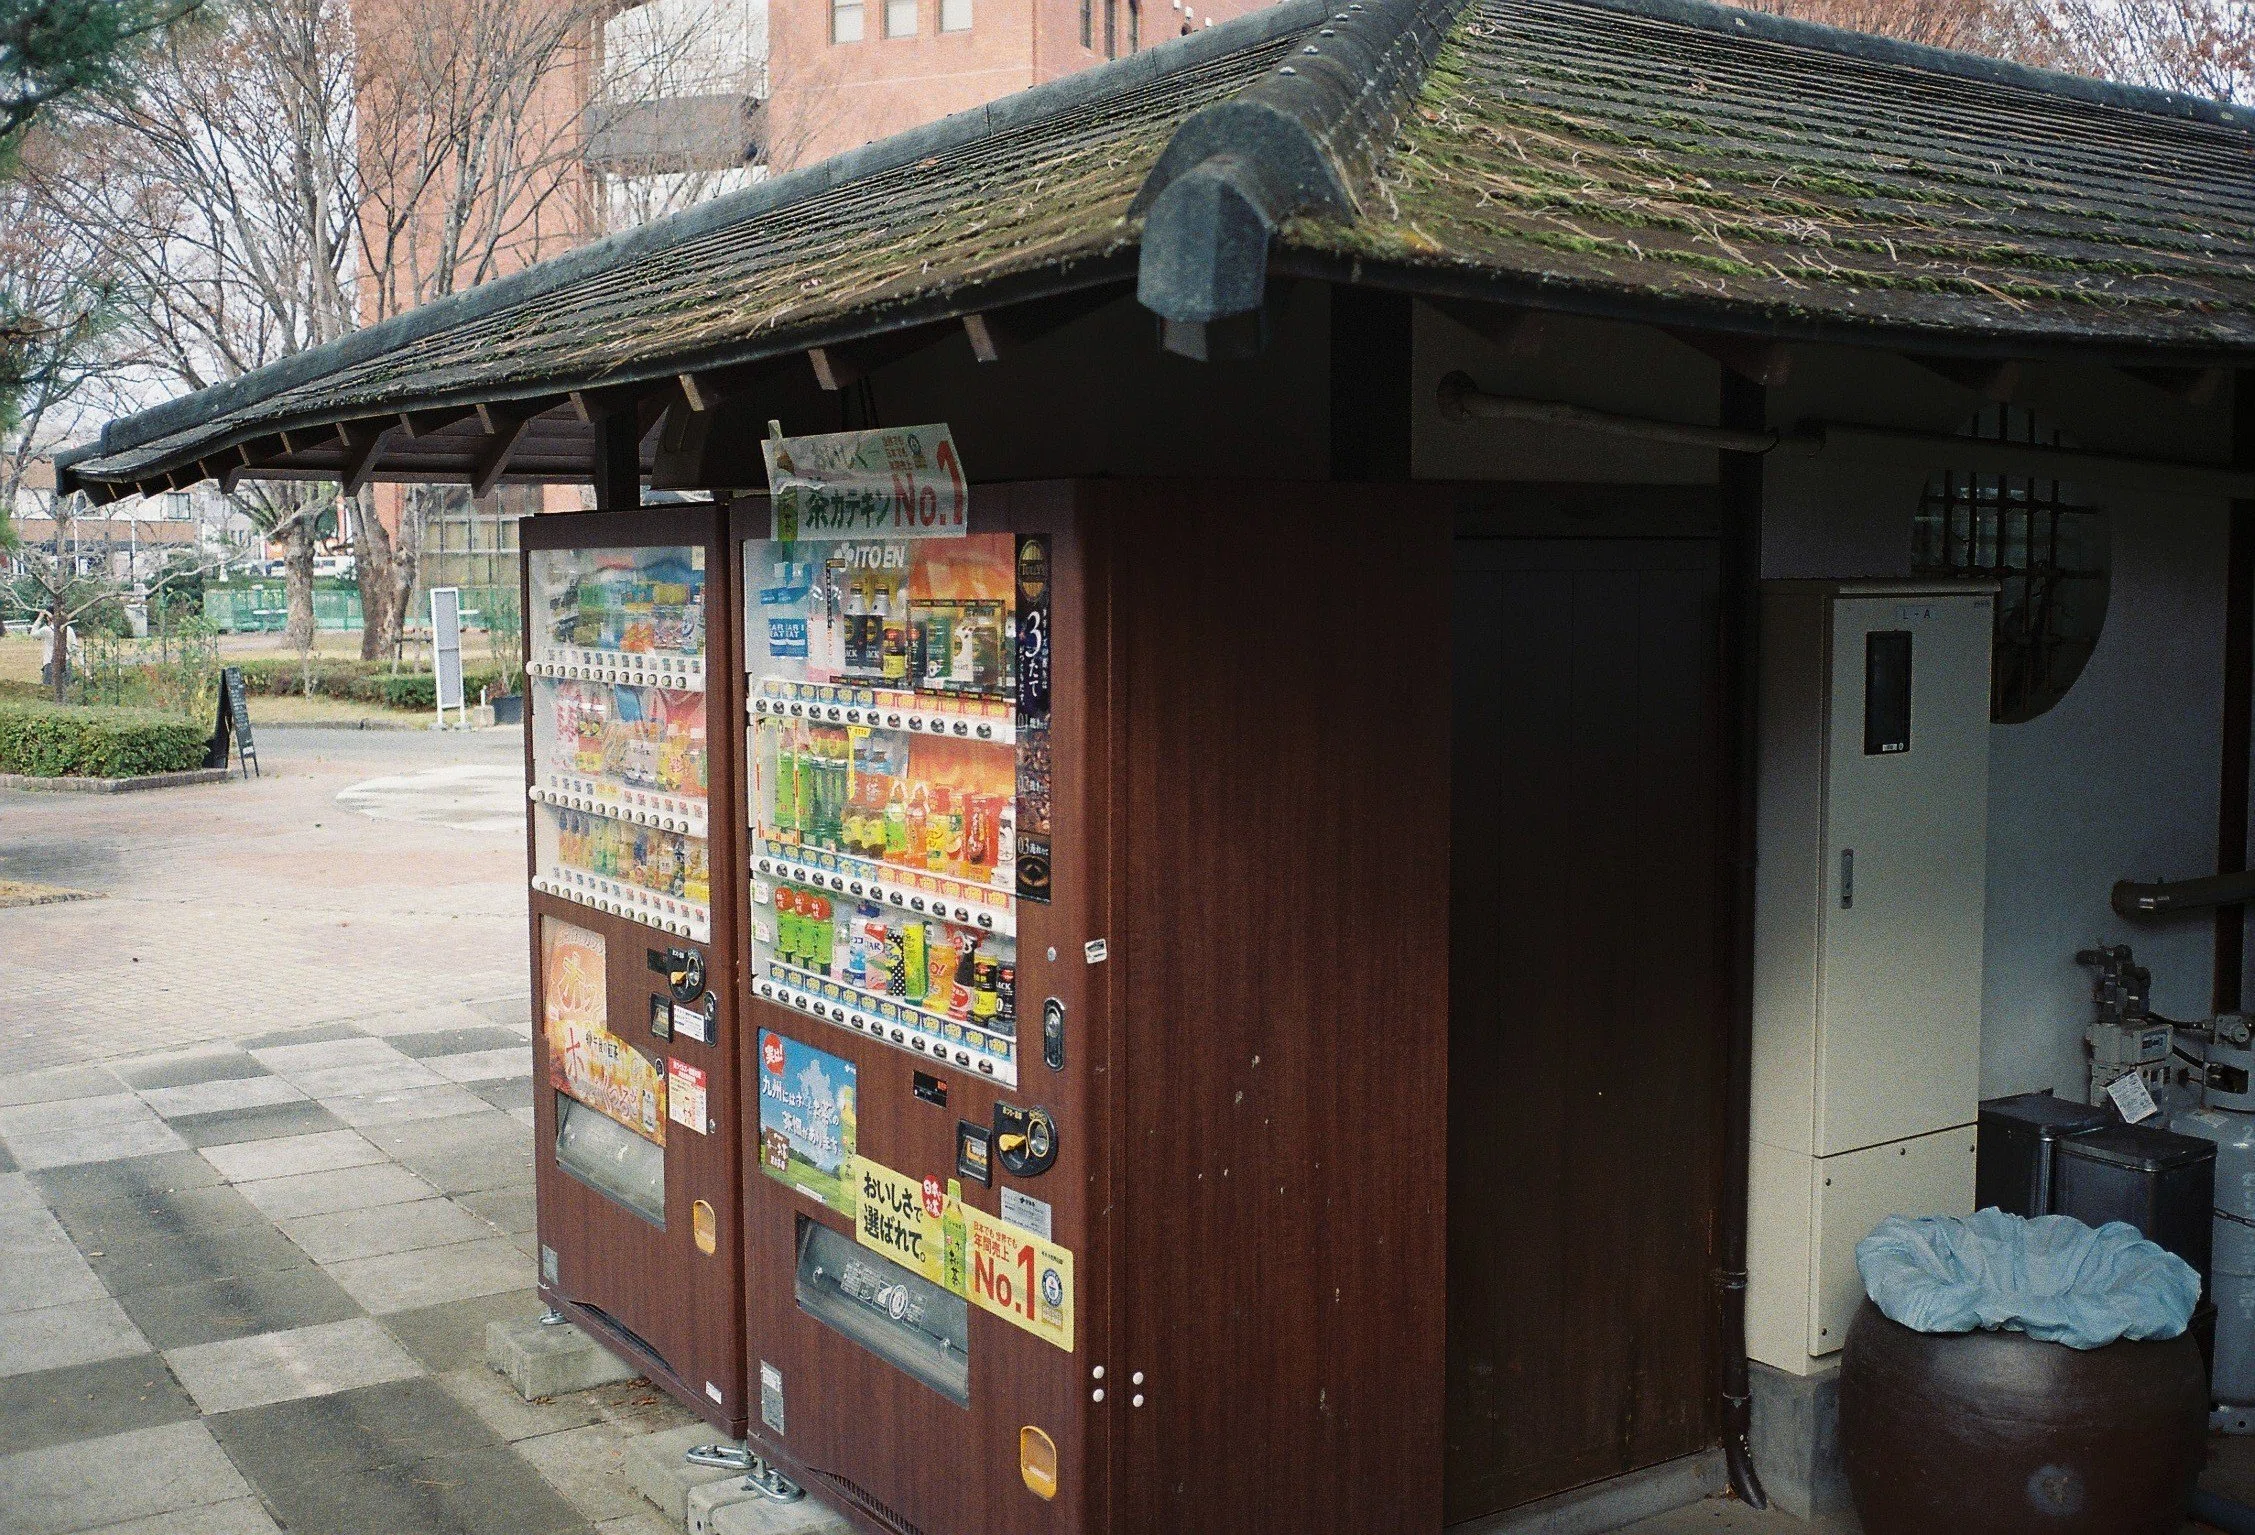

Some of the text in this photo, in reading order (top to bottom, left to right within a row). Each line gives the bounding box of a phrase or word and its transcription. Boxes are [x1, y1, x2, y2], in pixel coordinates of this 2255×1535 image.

[892, 440, 964, 528] No.1
[805, 487, 891, 530] 茶カテキン
[854, 546, 905, 569] ITO EN
[863, 1171, 923, 1223] おいしさで
[863, 1203, 926, 1263] 選ばれて。
[973, 1220, 995, 1238] 日本でも
[995, 1231, 1018, 1250] 世界でも
[973, 1232, 1010, 1263] 年間売上
[974, 1244, 1036, 1322] No.1
